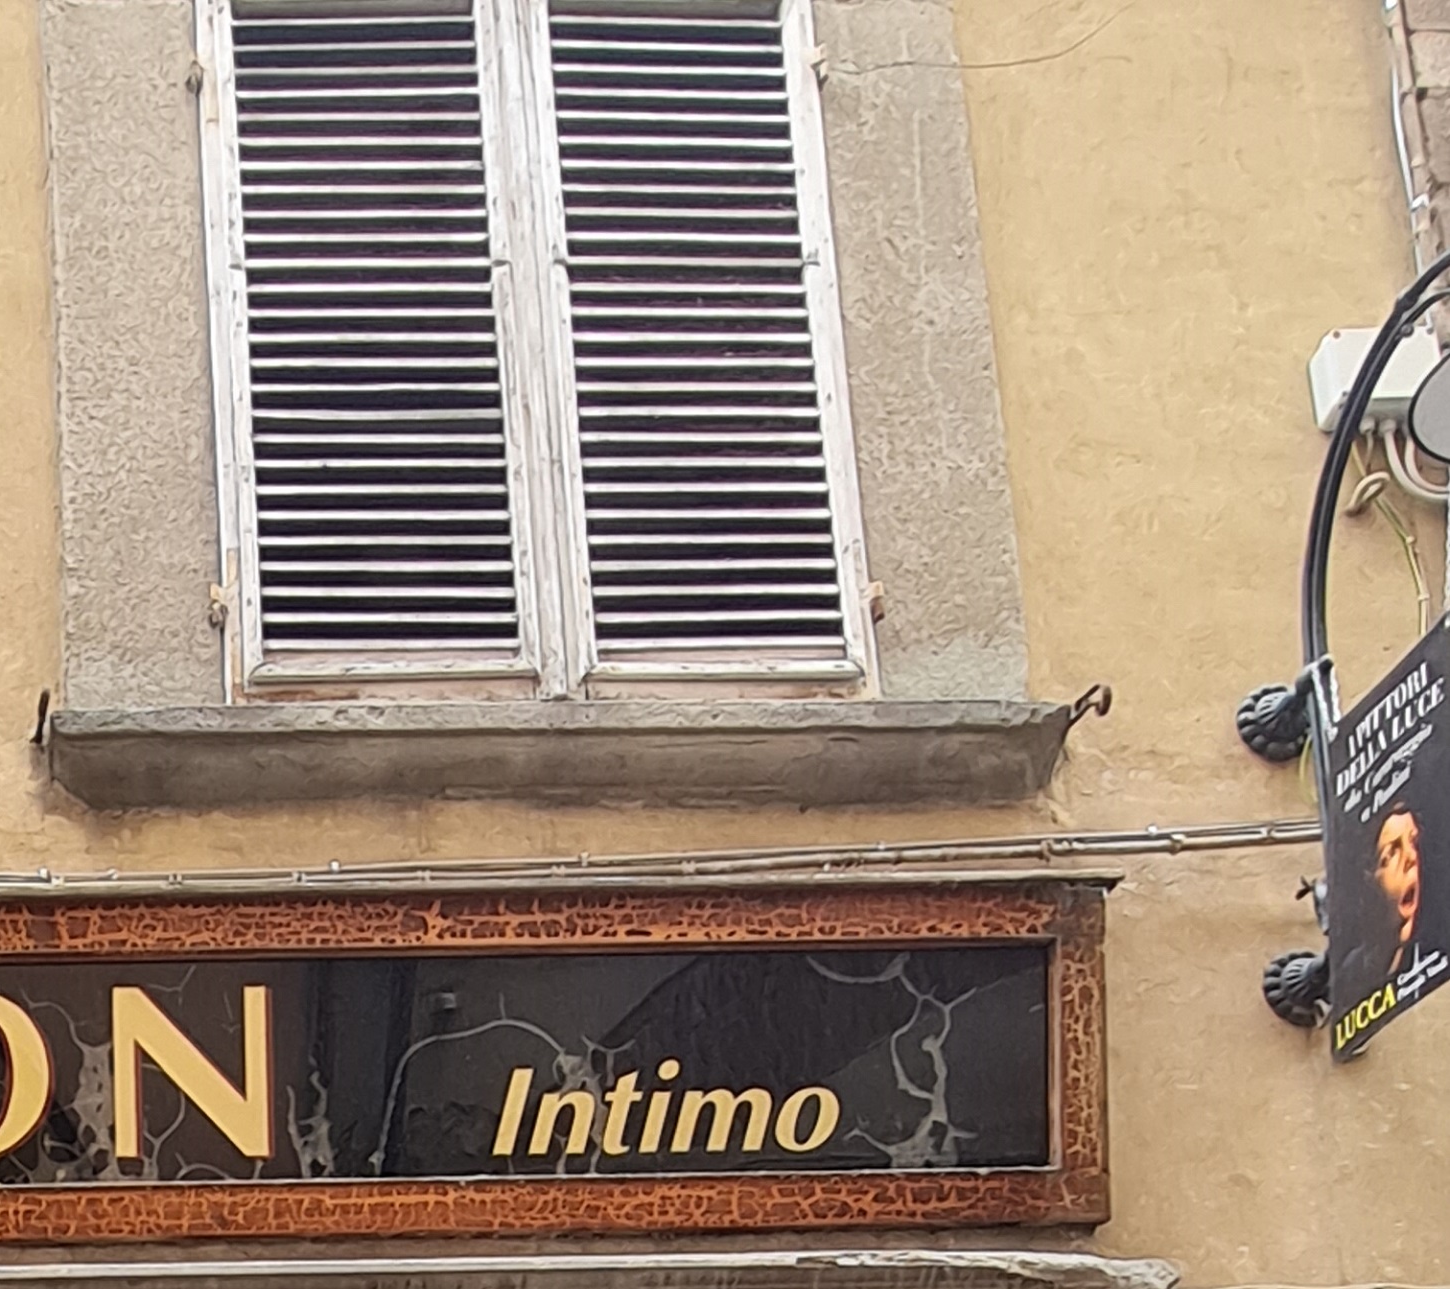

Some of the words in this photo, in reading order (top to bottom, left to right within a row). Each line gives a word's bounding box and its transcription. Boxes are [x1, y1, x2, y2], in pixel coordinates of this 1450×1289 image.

[1336, 734, 1387, 797] DELLA
[1391, 677, 1445, 742] LUCE
[1355, 661, 1428, 748] PITTORI
[1335, 982, 1397, 1051] LUCCA
[493, 1061, 840, 1157] Intimo
